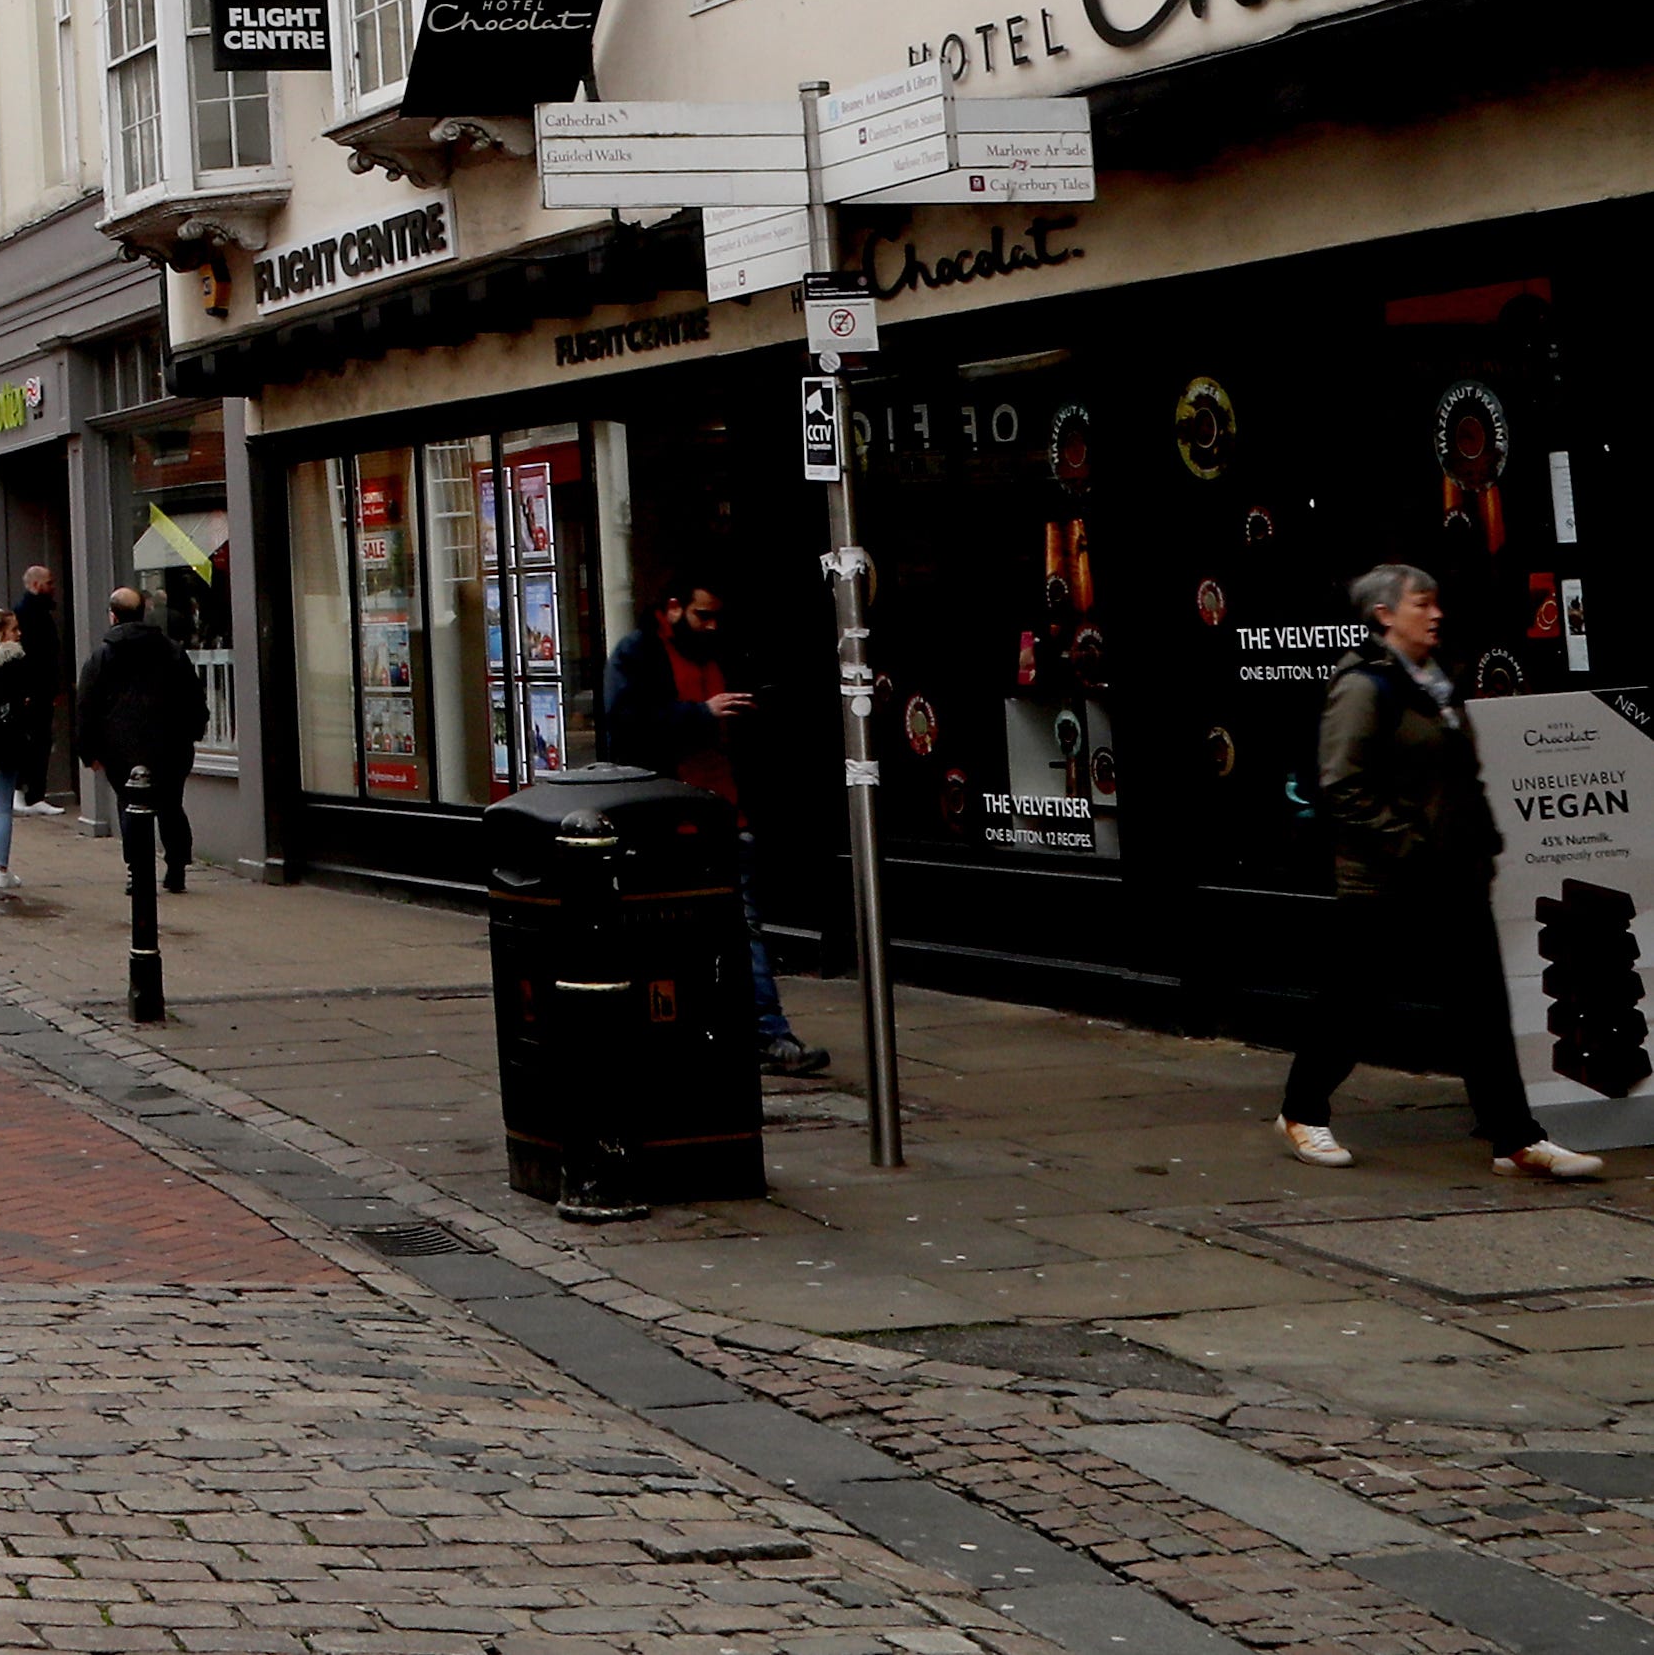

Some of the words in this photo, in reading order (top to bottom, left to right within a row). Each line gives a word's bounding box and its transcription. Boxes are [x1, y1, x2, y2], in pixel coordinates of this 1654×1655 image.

[482, 0, 546, 12] HOTEL
[228, 7, 322, 28] FLIGHT
[223, 30, 326, 50] CENTRE
[544, 113, 606, 127] Cathedral
[546, 149, 593, 164] Guided
[595, 149, 632, 162] Walks
[986, 144, 1041, 157] Marlowe
[1044, 143, 1087, 156] Arade
[989, 178, 1057, 195] Caerbury
[1059, 177, 1091, 191] Tales
[254, 242, 339, 304] FLIGHT
[338, 202, 448, 278] CENTRE
[554, 329, 628, 365] FLIGHT
[1435, 386, 1474, 455] HAZELNUT
[1474, 387, 1508, 452] PRALINE
[807, 424, 832, 442] CCTV
[363, 541, 386, 559] SALE
[1235, 627, 1272, 650] THE
[1274, 624, 1370, 650] VELVETISER
[1239, 665, 1264, 681] ONE
[1316, 664, 1331, 680] 12
[1614, 694, 1652, 726] NEW
[1547, 722, 1574, 730] HOTEL
[1511, 770, 1627, 792] UNBELIEVABLY
[982, 792, 1011, 815] THE
[1011, 794, 1092, 819] VELVETISER
[1513, 789, 1630, 823] VEGAN
[984, 827, 1006, 842] ONE
[1045, 831, 1057, 845] 12
[1540, 836, 1564, 847] 45%
[1524, 849, 1592, 865] Outrageously
